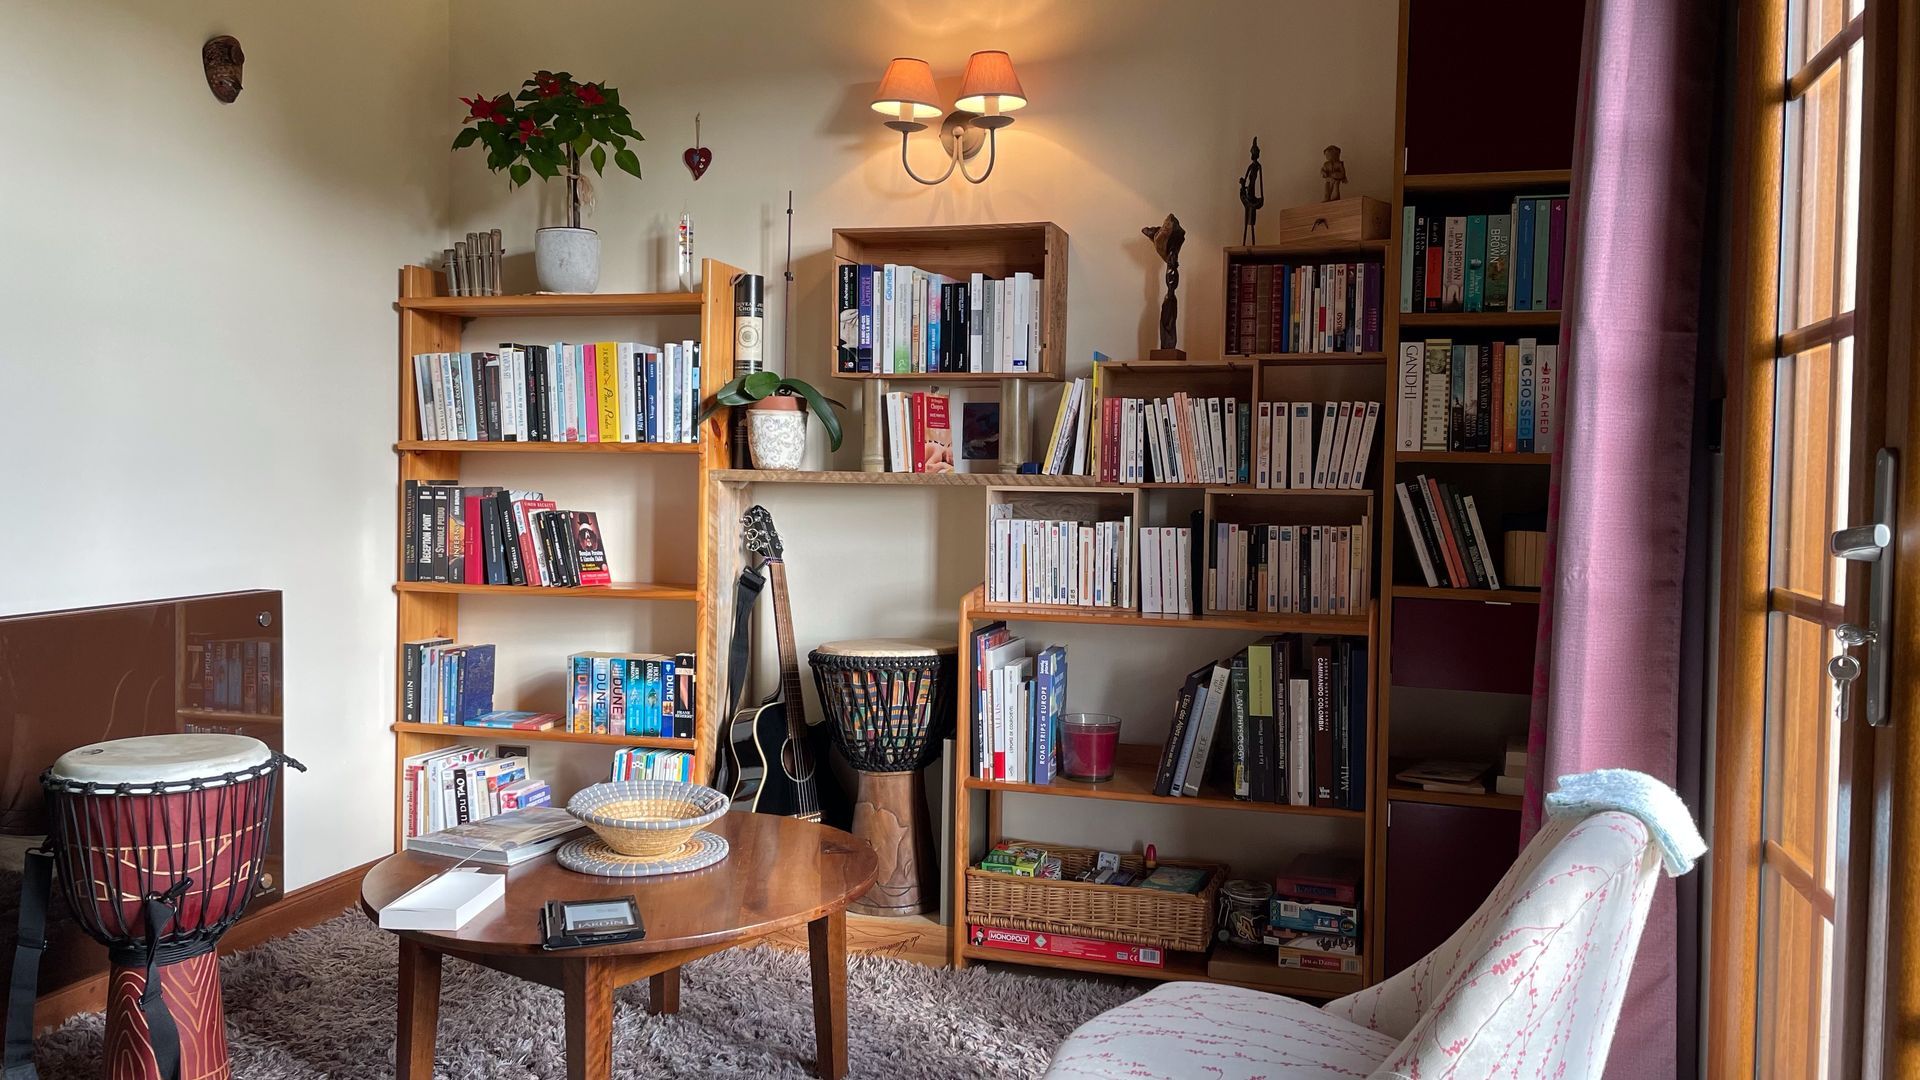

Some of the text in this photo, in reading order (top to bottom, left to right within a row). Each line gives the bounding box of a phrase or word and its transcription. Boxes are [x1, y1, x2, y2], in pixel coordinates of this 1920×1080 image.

[1489, 229, 1500, 263] BROWN
[1500, 236, 1508, 256] DAN
[1405, 345, 1418, 399] GANDHI
[1520, 368, 1532, 436] CROSSED
[1540, 378, 1549, 434] REACHED
[420, 513, 432, 563] DECEPTION POINT
[435, 526, 445, 553] SYMBOLE
[578, 674, 587, 711] DUNE
[596, 673, 606, 709] DUNE
[612, 678, 623, 714] DUNE
[666, 674, 674, 701] DUNE
[1181, 694, 1192, 709] L'Eau
[1174, 720, 1184, 737] Alpes
[1179, 709, 1187, 720] des
[1237, 714, 1245, 761] PHYSIOLOGY
[457, 778, 466, 812] DU TAO
[988, 932, 1029, 943] MONOPOLY
